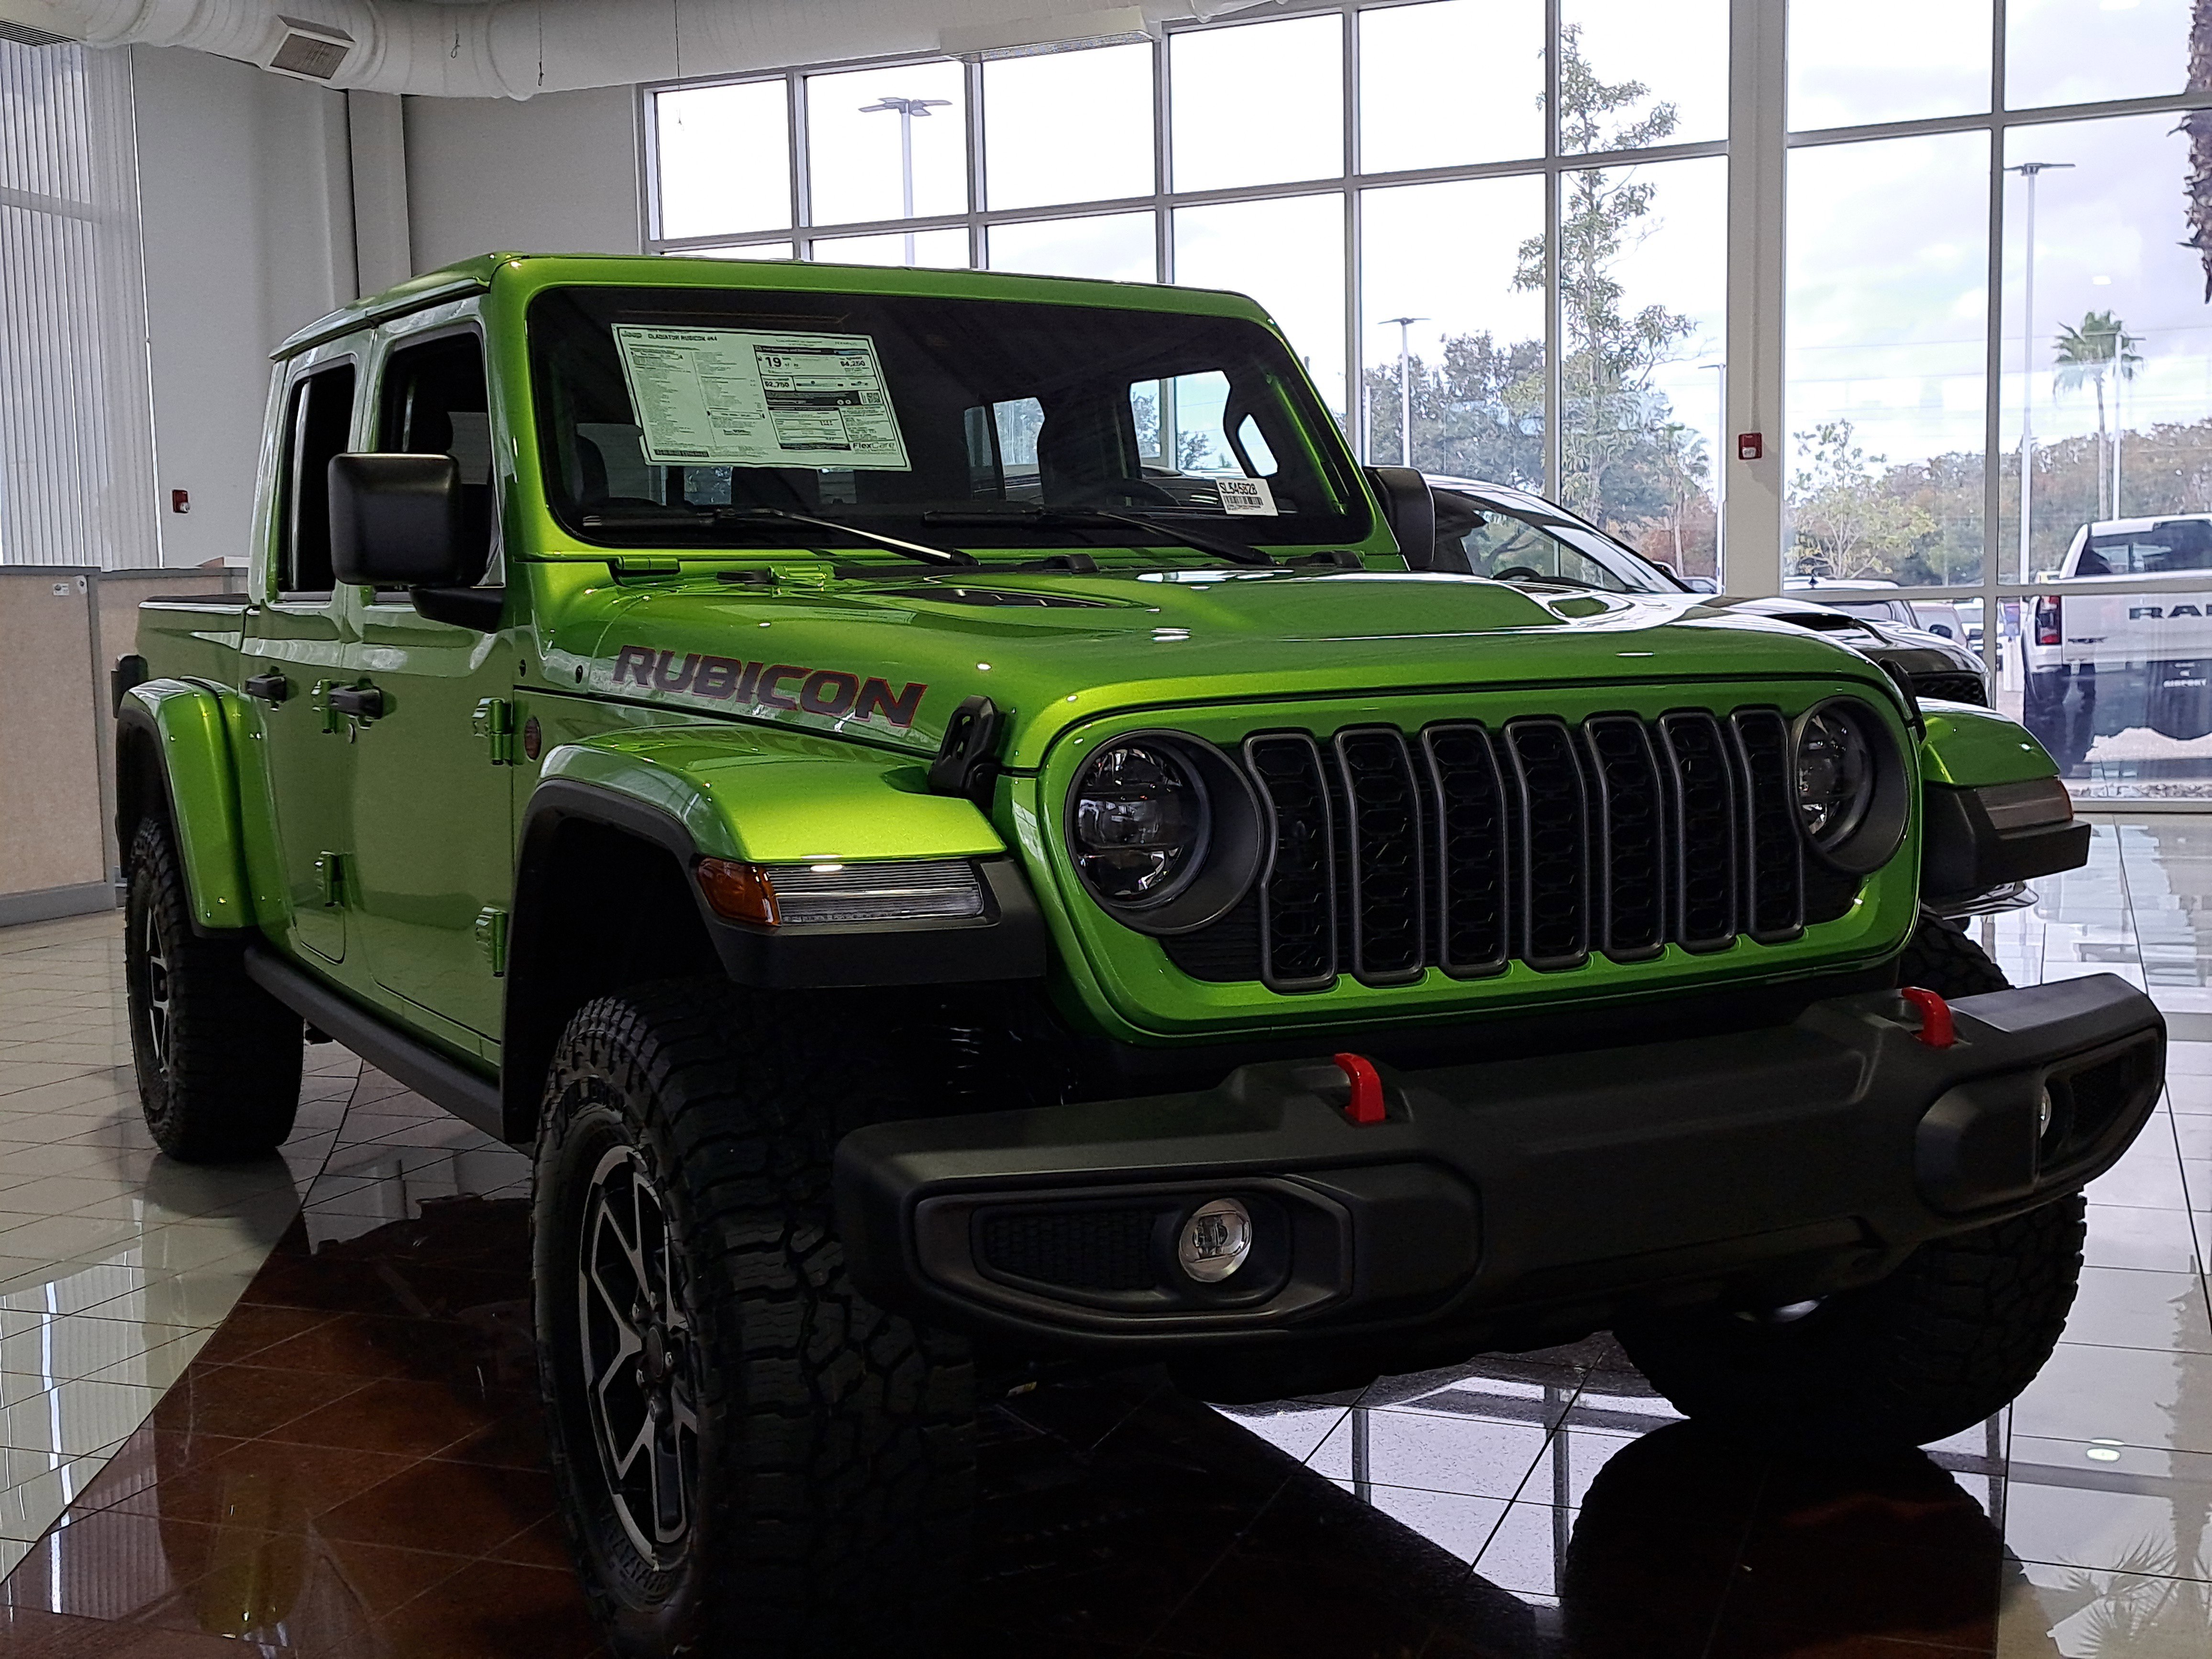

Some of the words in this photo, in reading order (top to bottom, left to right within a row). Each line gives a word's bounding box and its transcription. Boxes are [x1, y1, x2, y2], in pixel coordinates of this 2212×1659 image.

[765, 356, 782, 367] 19
[2129, 604, 2212, 619] RA
[611, 644, 928, 728] RUBICON
